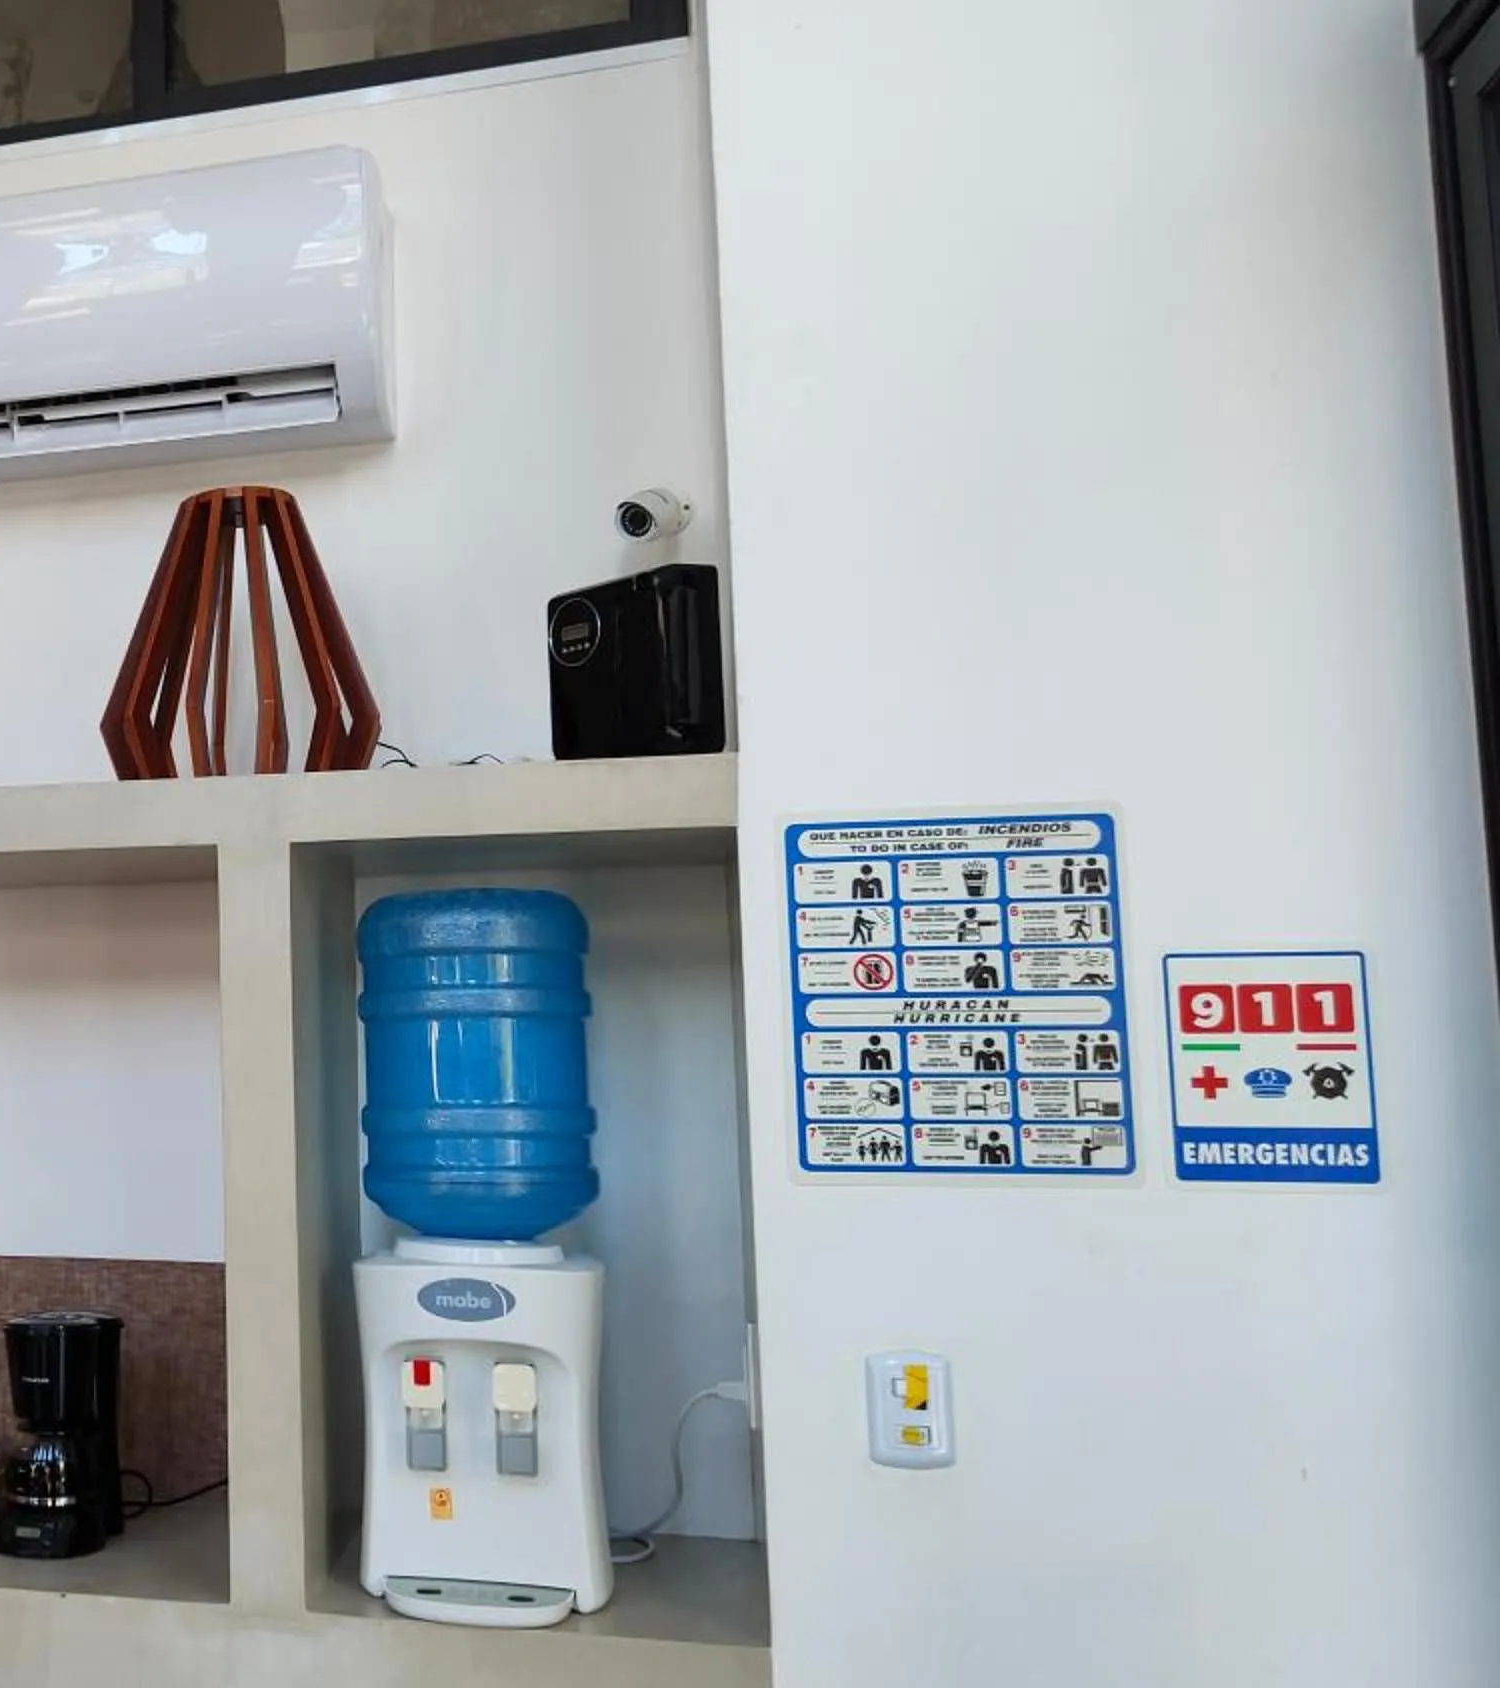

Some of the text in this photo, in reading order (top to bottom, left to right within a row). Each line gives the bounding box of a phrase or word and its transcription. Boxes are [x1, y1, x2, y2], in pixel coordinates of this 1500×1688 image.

[809, 831, 836, 841] QUE
[839, 830, 882, 840] HACER
[886, 829, 904, 838] EN
[907, 828, 943, 837] CASO
[978, 823, 1072, 835] INCENDIOS
[850, 844, 867, 853] TO
[871, 844, 889, 852] DO
[893, 843, 906, 852] IN
[910, 842, 945, 851] CASE
[1006, 837, 1045, 848] FIRE
[901, 864, 909, 874] 2
[1008, 860, 1016, 870] 3
[797, 866, 803, 876] 1
[904, 909, 911, 918] 5
[1010, 906, 1018, 916] 6
[799, 912, 807, 922] 4
[801, 957, 809, 966] 7
[906, 955, 914, 965] 8
[1012, 952, 1021, 962] 9
[903, 1000, 1009, 1010] HURACAN
[1191, 990, 1337, 1028] 911
[893, 1013, 1021, 1023] HURRICANE
[806, 1035, 811, 1044] 1
[910, 1035, 918, 1044] 2
[1018, 1034, 1025, 1044] 3
[806, 1081, 814, 1091] 4
[912, 1081, 920, 1091] 5
[1020, 1082, 1028, 1091] 6
[809, 1128, 817, 1137] 7
[914, 1128, 923, 1138] 8
[1022, 1128, 1031, 1138] 9
[1182, 1141, 1369, 1167] EMERGENCIAS
[435, 1291, 492, 1309] mabe
